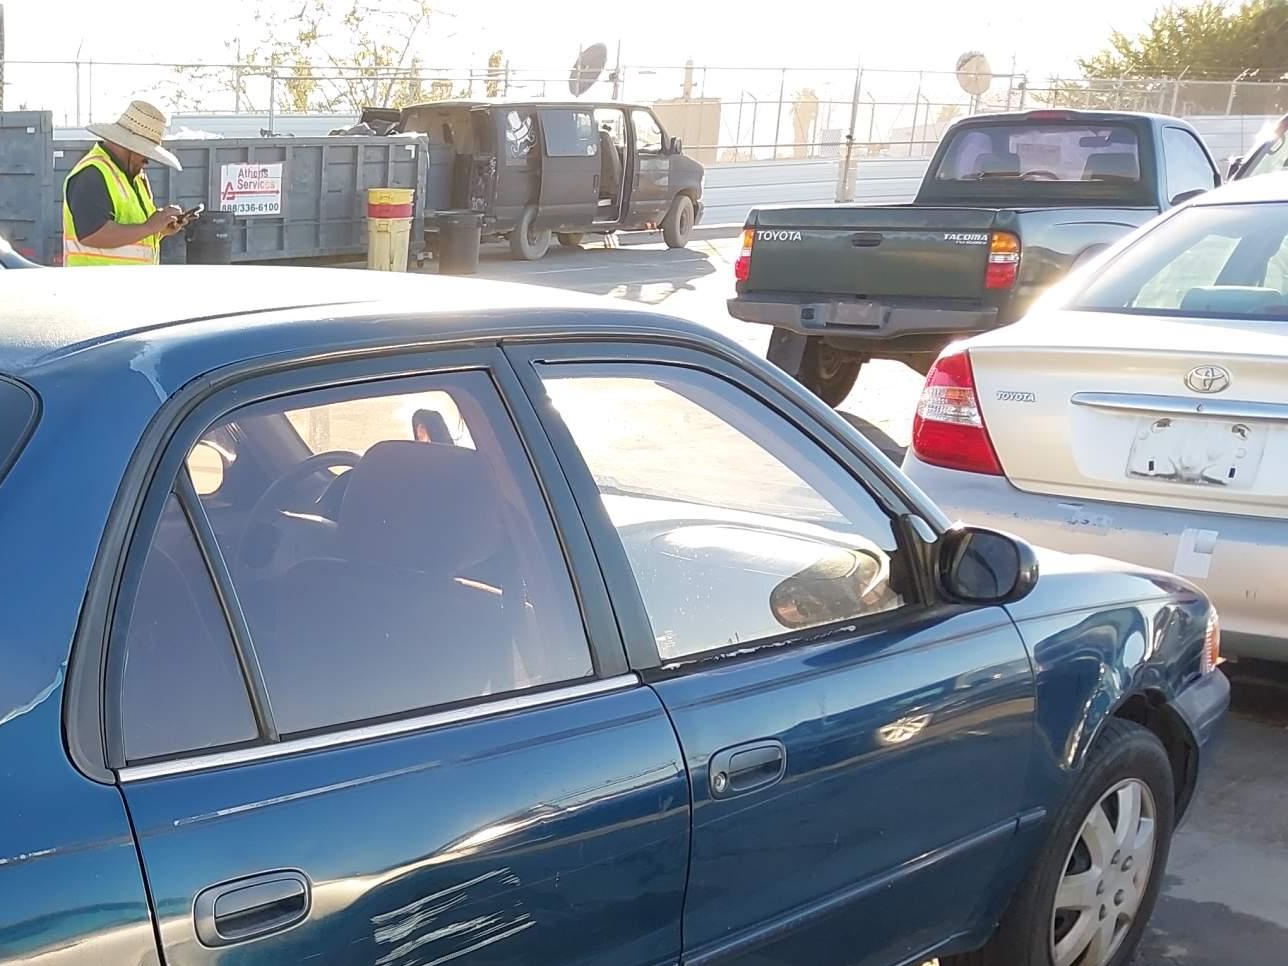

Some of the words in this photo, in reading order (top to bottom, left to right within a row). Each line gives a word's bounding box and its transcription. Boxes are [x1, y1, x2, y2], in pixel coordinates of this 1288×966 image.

[238, 167, 269, 179] Athens
[237, 178, 276, 190] Services
[756, 230, 802, 241] TOYOTA
[943, 232, 988, 241] TACOMA
[996, 390, 1036, 403] TOYOTA
